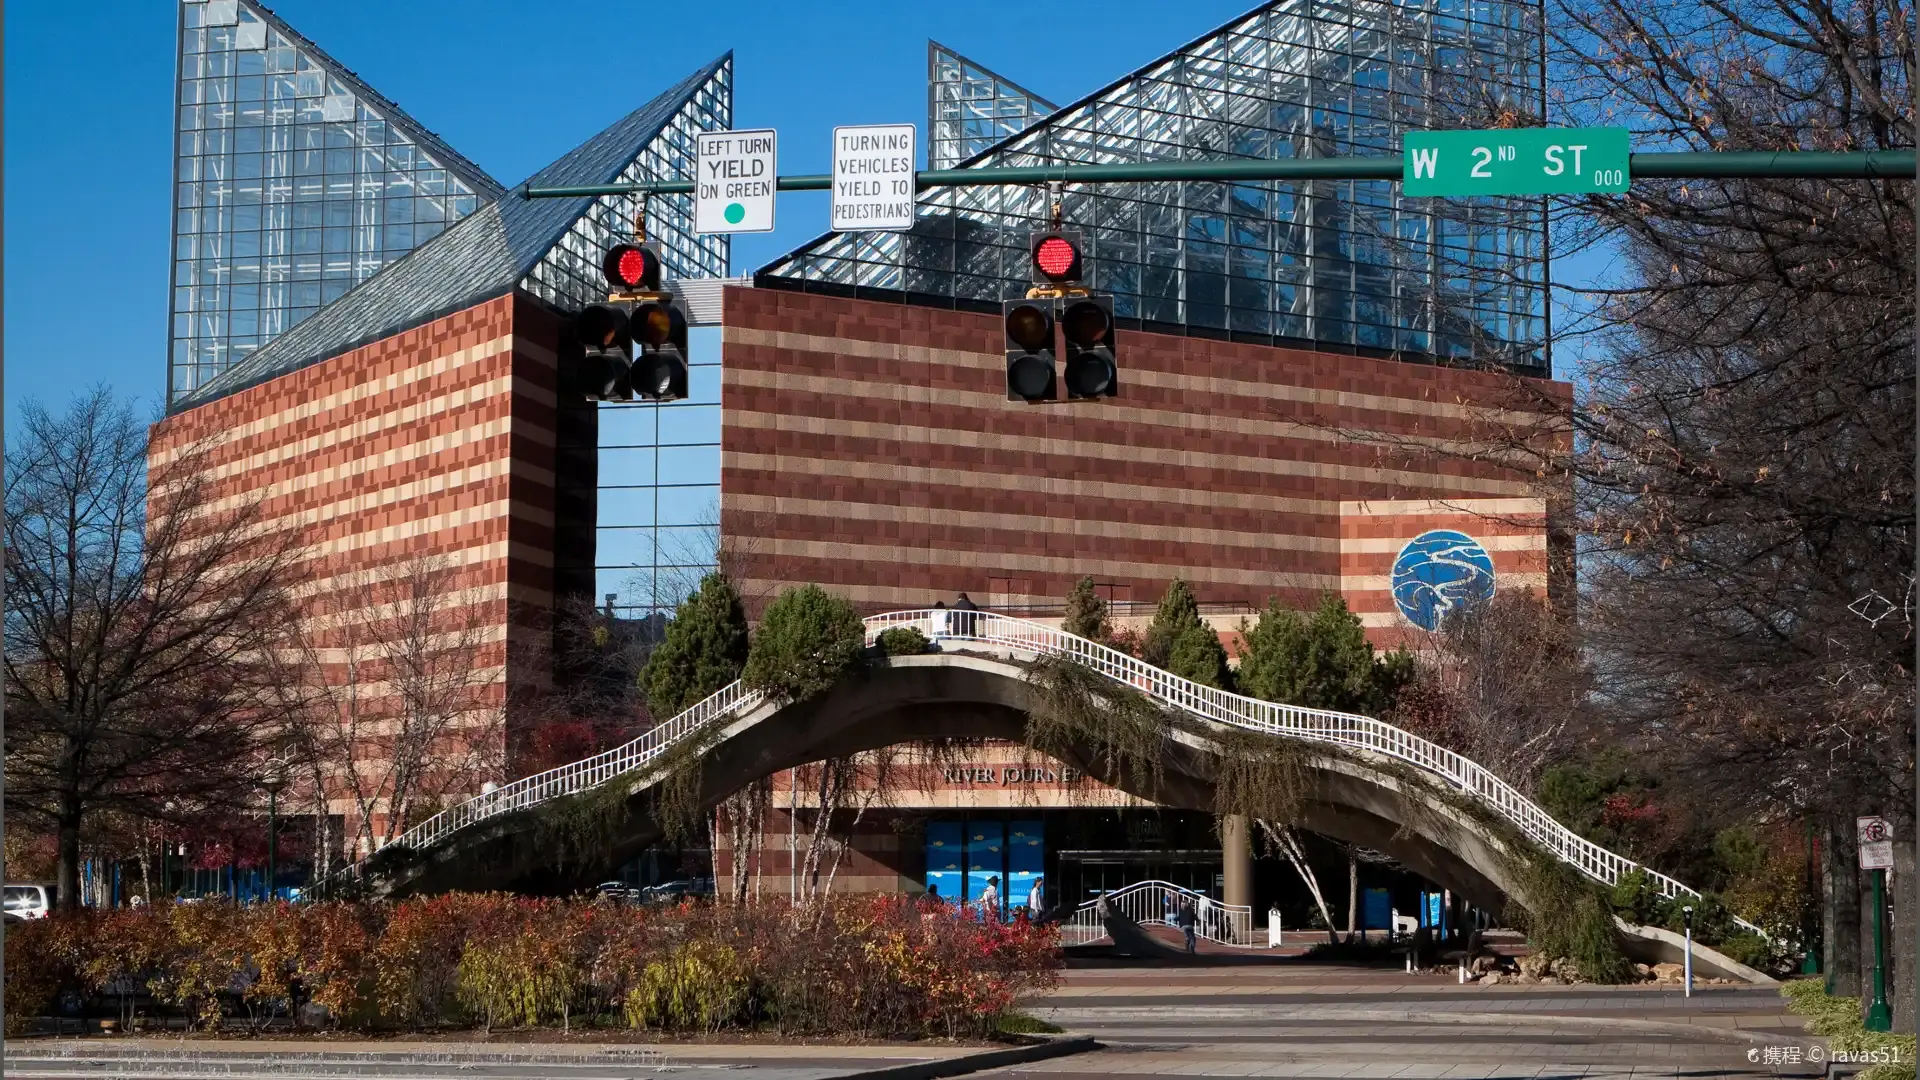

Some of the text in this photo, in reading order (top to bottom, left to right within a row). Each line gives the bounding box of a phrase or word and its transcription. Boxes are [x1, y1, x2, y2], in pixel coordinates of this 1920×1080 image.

[701, 137, 772, 156] LEFT TURN
[841, 134, 908, 151] TURNING
[708, 158, 765, 179] YIELD
[840, 157, 909, 175] VEHICLES
[1411, 147, 1439, 179] W
[1543, 144, 1588, 176] ST
[1594, 169, 1623, 187] 000
[700, 180, 771, 200] ON GREEN
[839, 179, 909, 197] YIELD TO
[835, 202, 911, 220] PEDESTRIANS
[943, 766, 997, 784] RIVER
